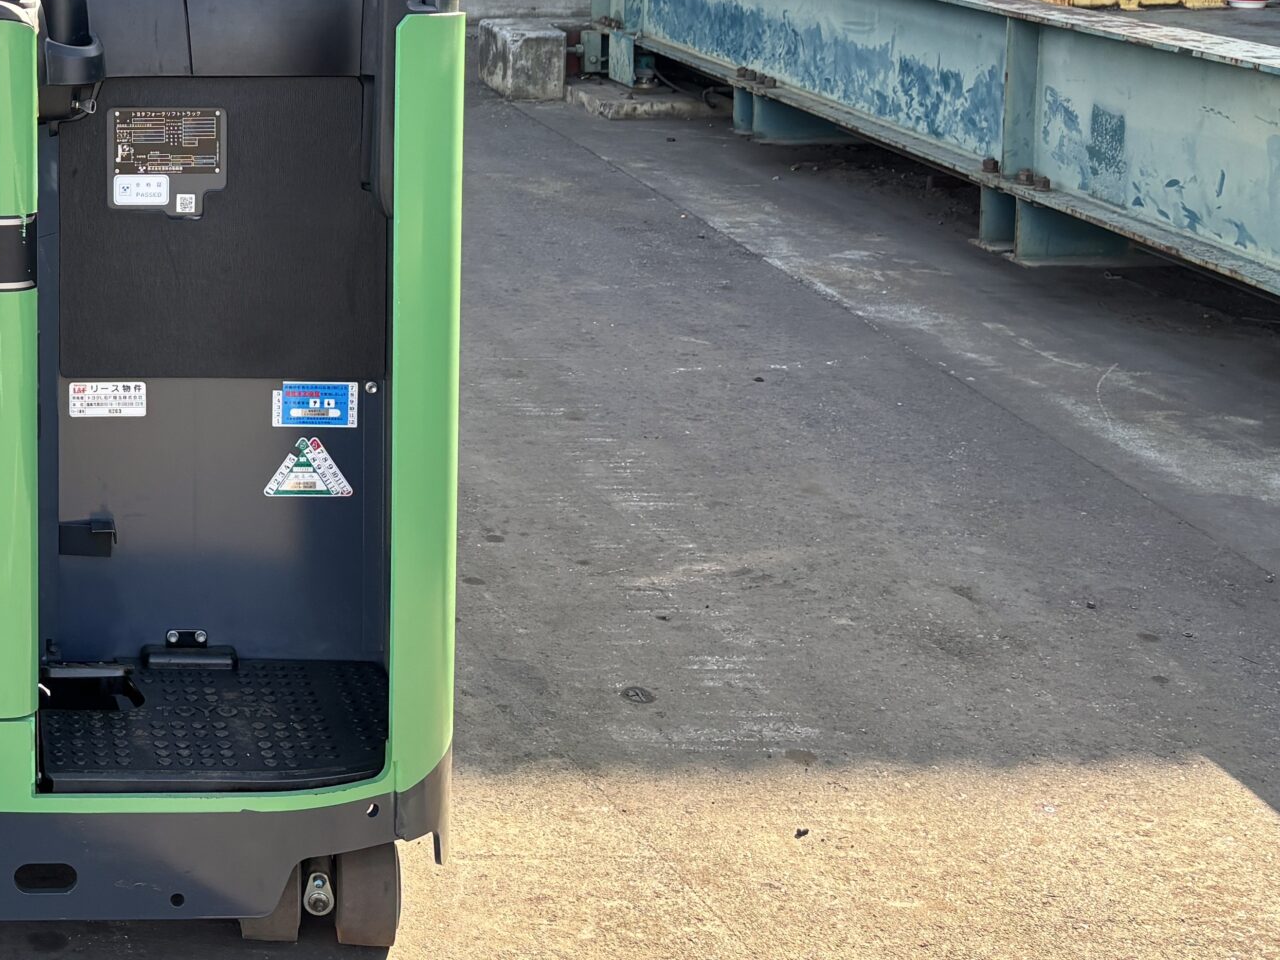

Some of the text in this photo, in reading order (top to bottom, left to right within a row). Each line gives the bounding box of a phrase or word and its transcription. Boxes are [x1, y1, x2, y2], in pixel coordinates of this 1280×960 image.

[90, 384, 142, 393] リース物件
